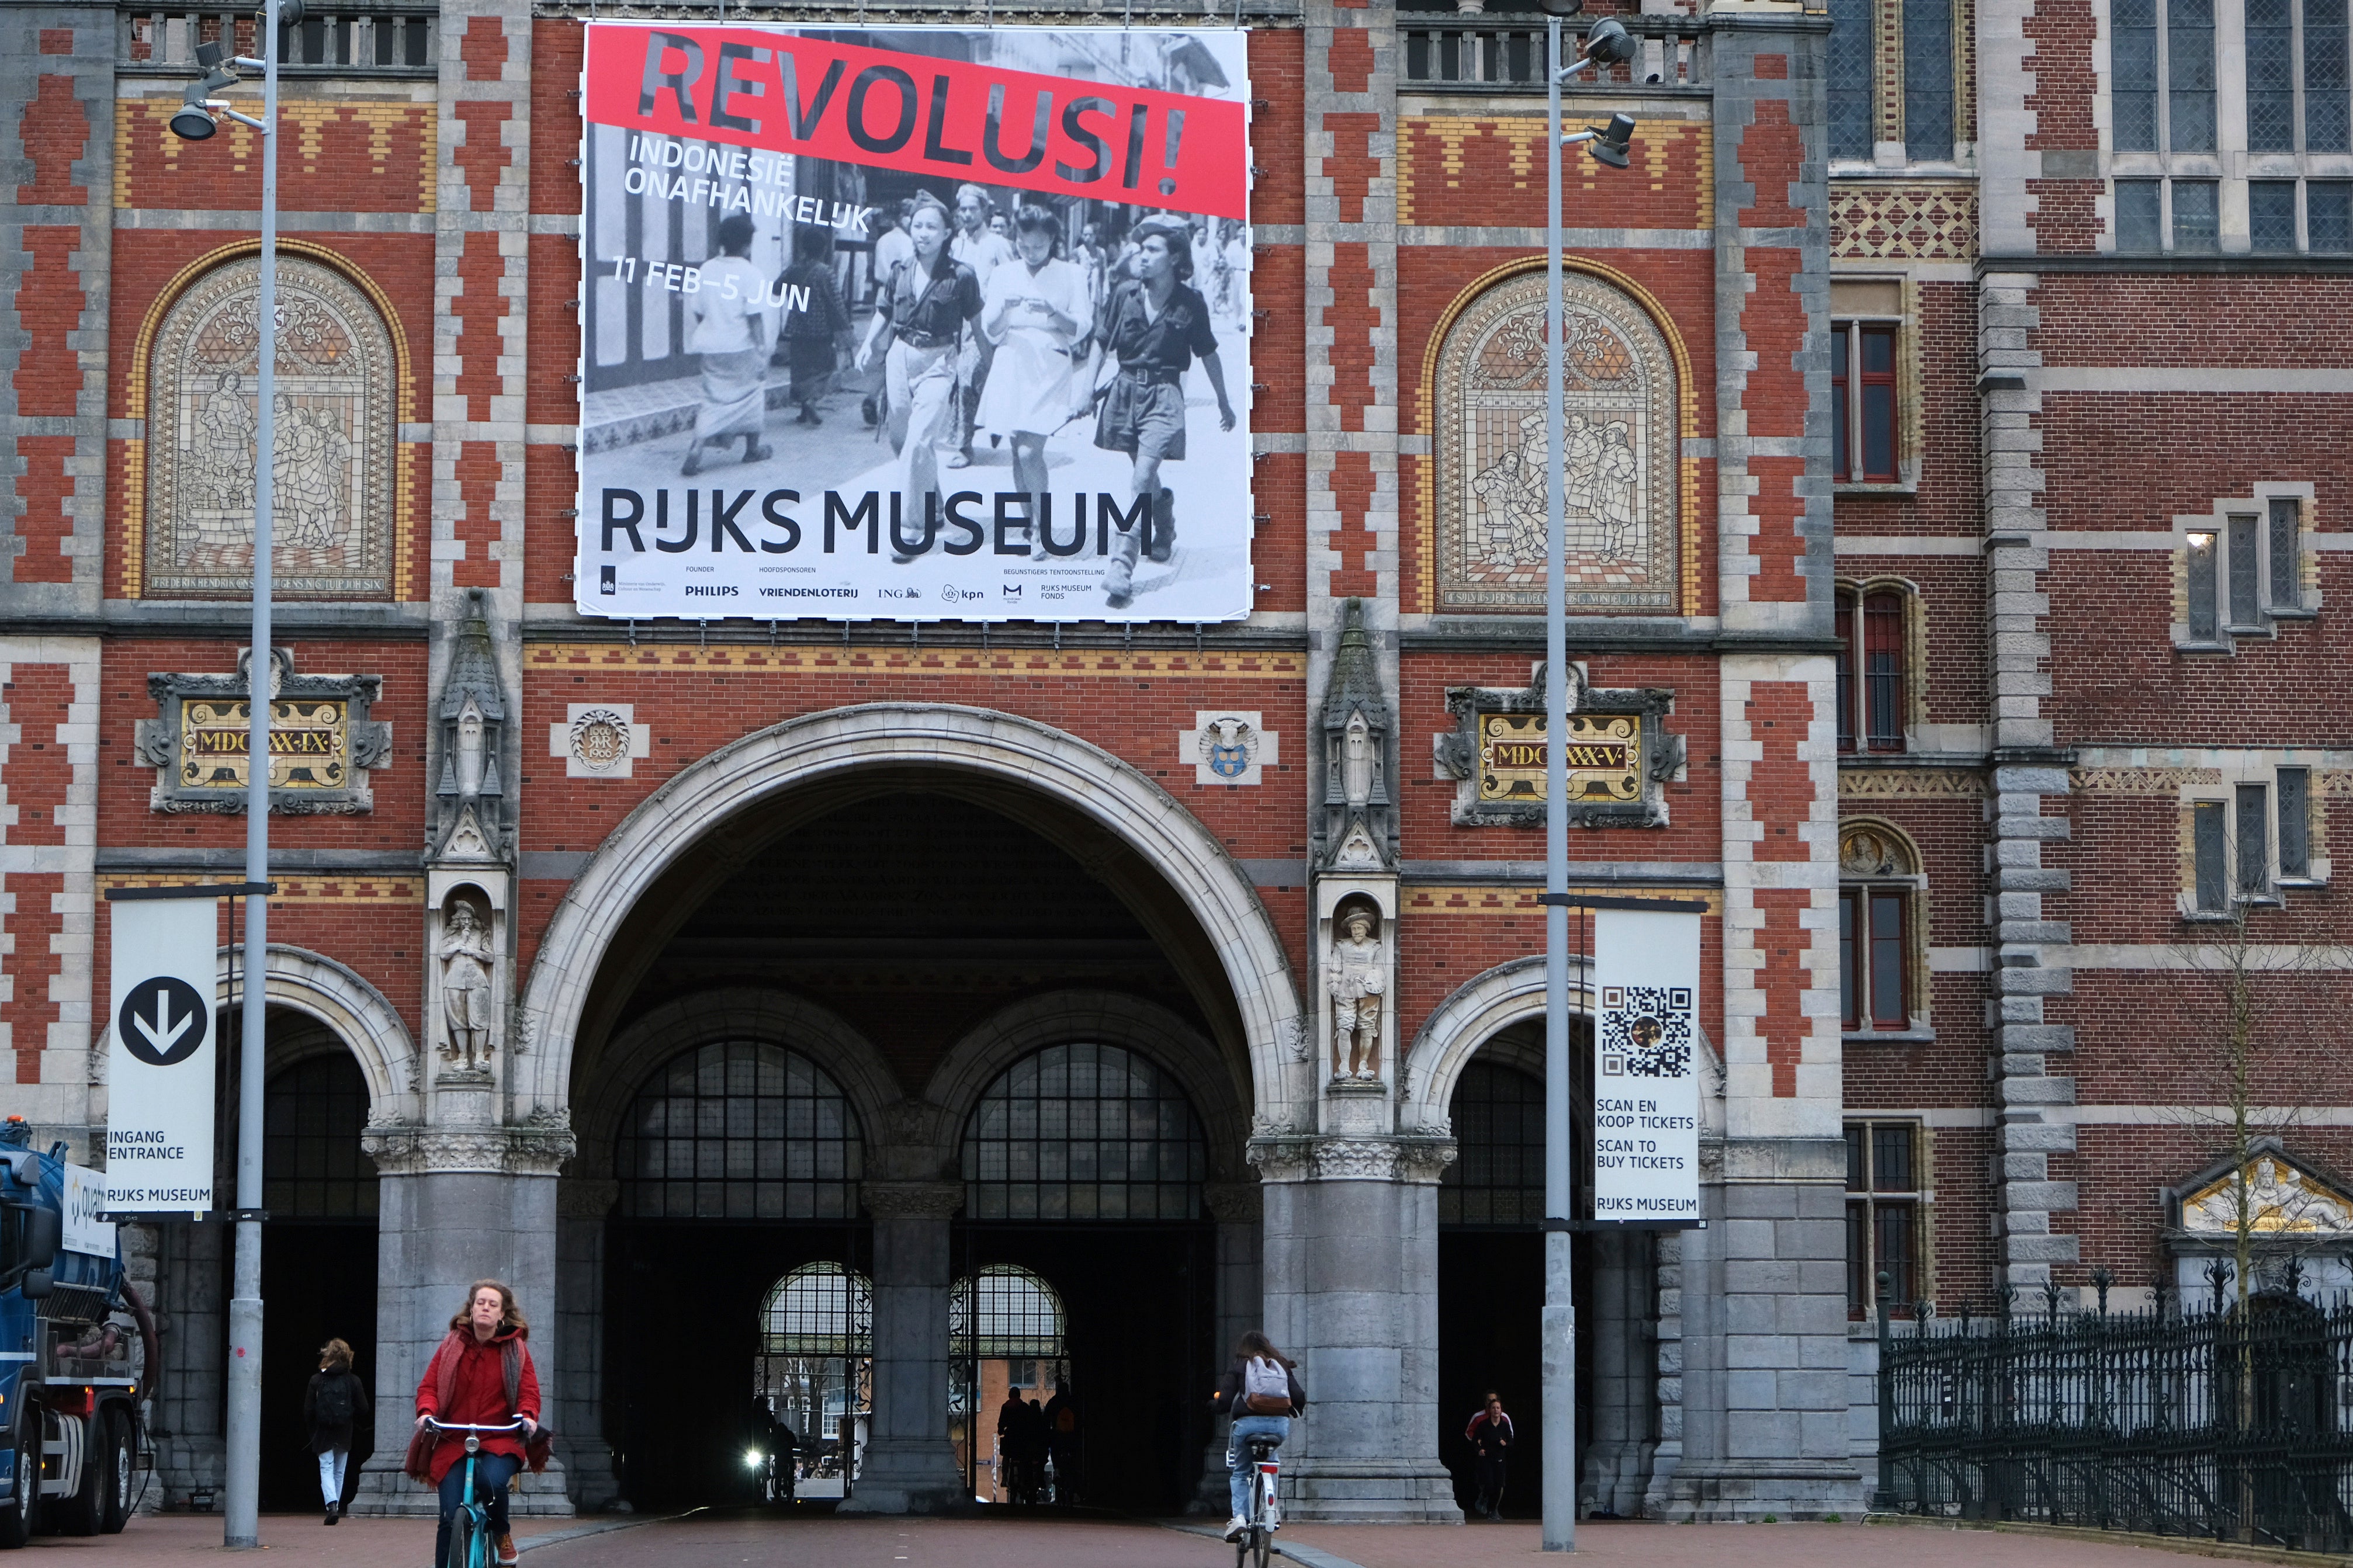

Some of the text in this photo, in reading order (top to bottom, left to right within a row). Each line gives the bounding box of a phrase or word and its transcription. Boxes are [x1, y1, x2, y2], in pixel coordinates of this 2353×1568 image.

[637, 31, 1187, 196] REVOLUSI!
[630, 135, 793, 188] INDONESIË
[623, 167, 873, 234] ONAFHANKELIJK
[613, 255, 636, 284] 11
[747, 279, 810, 313] JUN
[601, 488, 1153, 557] RIJKS MUSEUM
[154, 578, 196, 587] FREDERIK
[197, 578, 234, 587] HENDRIK
[685, 585, 739, 596] PHILIPS
[759, 588, 858, 599] VRIENDENLOTERIJ
[878, 589, 903, 598] ING
[961, 589, 984, 601] kpn
[1590, 594, 1623, 603] VONDEL
[589, 726, 612, 736] 1606
[588, 748, 612, 758] 1906
[1597, 1099, 1657, 1112] SCAN EN
[1597, 1115, 1694, 1129] KOOP TICKETS
[109, 1131, 165, 1143] INGANG
[1597, 1139, 1657, 1153] SCAN TO
[109, 1147, 184, 1160] ENTRANCE
[1597, 1156, 1684, 1169] BUY TICKETS
[108, 1189, 210, 1202] RIJKS MUSEUM
[82, 1182, 106, 1230] quatr
[1597, 1198, 1697, 1212] RIJKS MUSEUM
